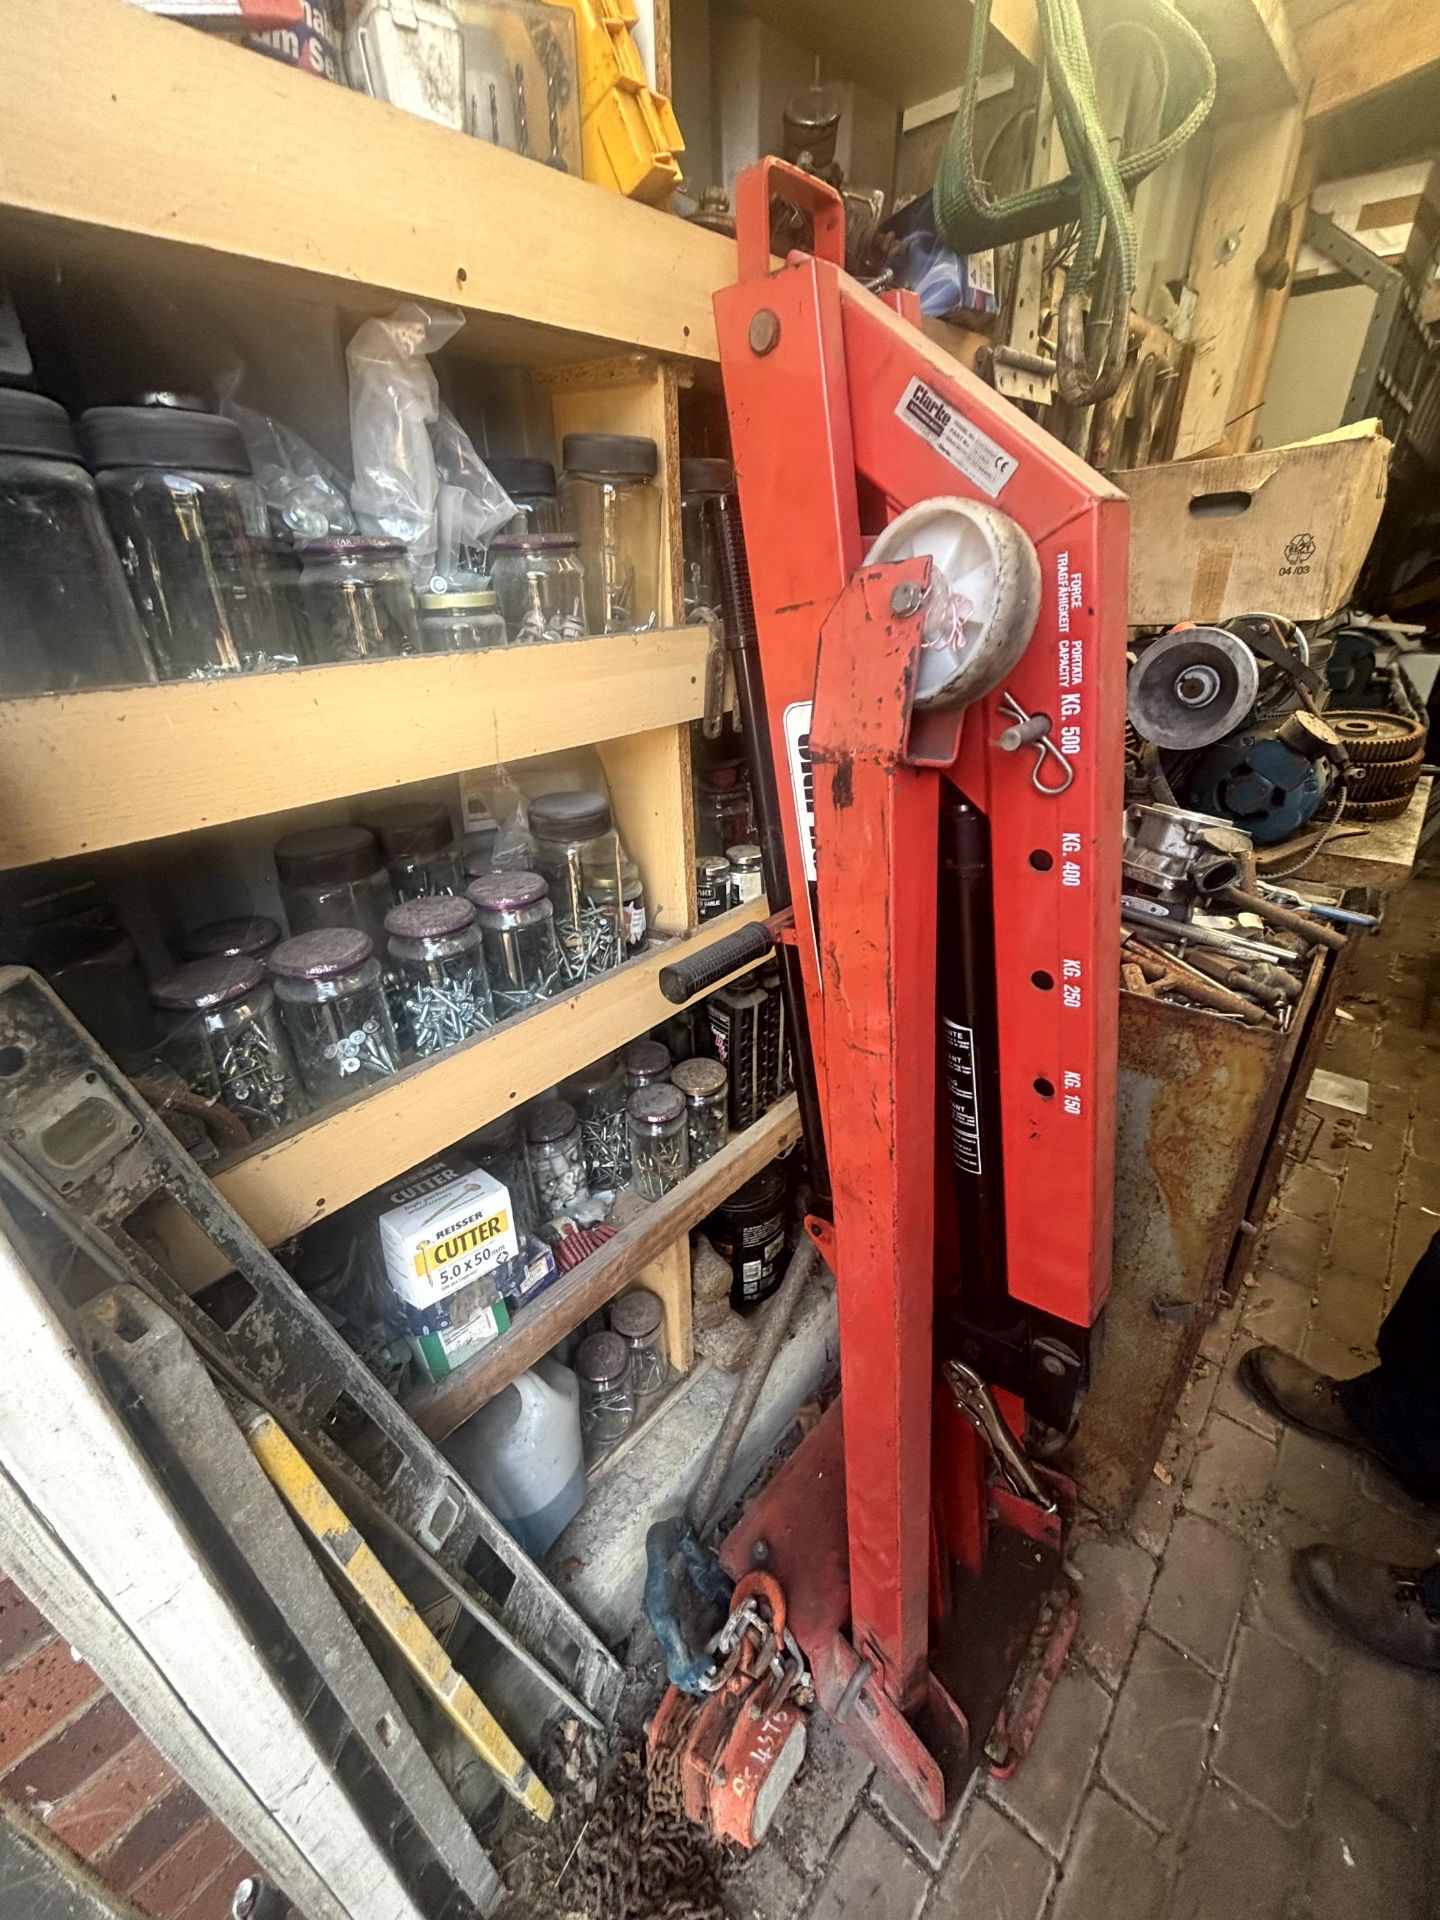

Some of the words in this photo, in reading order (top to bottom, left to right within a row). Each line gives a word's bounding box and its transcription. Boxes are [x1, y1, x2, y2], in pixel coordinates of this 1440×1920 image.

[912, 384, 952, 427] Clarke
[1057, 550, 1071, 633] TRAGFÄHIGKEIT
[1070, 572, 1083, 609] FORCE
[1059, 639, 1070, 688] CAPACITY
[1071, 639, 1083, 686] PORTATA
[1061, 692, 1082, 722] KG.
[1061, 726, 1081, 755] 500
[1062, 832, 1082, 857] KG.
[1062, 860, 1081, 887] 400
[1063, 958, 1082, 980] KG.
[1063, 983, 1082, 1008] 250
[1064, 1070, 1082, 1089] KG.
[1064, 1094, 1082, 1115] 150
[390, 1168, 460, 1204] CUTTER
[435, 1210, 484, 1240] REISSER
[434, 1216, 502, 1265] CUTTER
[440, 1264, 461, 1285] 5.0
[463, 1259, 474, 1273] x
